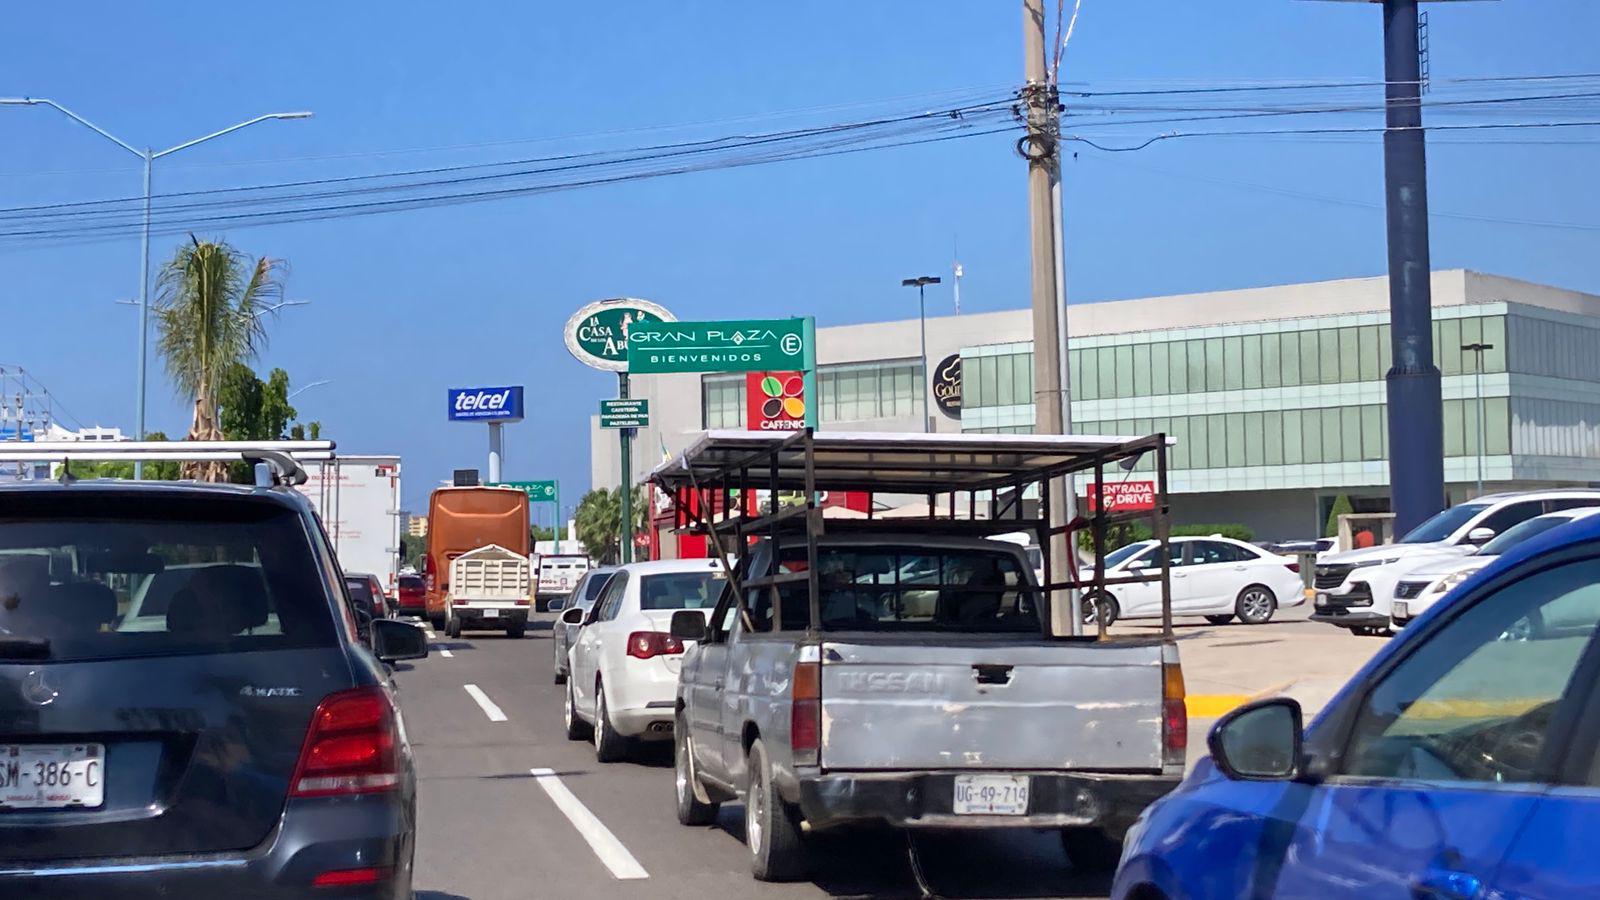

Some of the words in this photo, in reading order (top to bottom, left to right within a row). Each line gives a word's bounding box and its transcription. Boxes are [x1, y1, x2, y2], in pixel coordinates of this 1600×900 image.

[590, 316, 600, 327] LA
[579, 326, 613, 342] CASA
[630, 331, 696, 342] GRAN
[707, 330, 777, 345] PLAZA
[650, 353, 762, 363] BIENVENIDOS
[455, 389, 510, 411] telcel
[760, 420, 806, 429] CAFFENIO
[1102, 484, 1152, 494] ENTRADA
[1116, 493, 1153, 505] DRIVE
[839, 671, 945, 693] NISSAN
[956, 784, 1027, 803] UG-49-714
